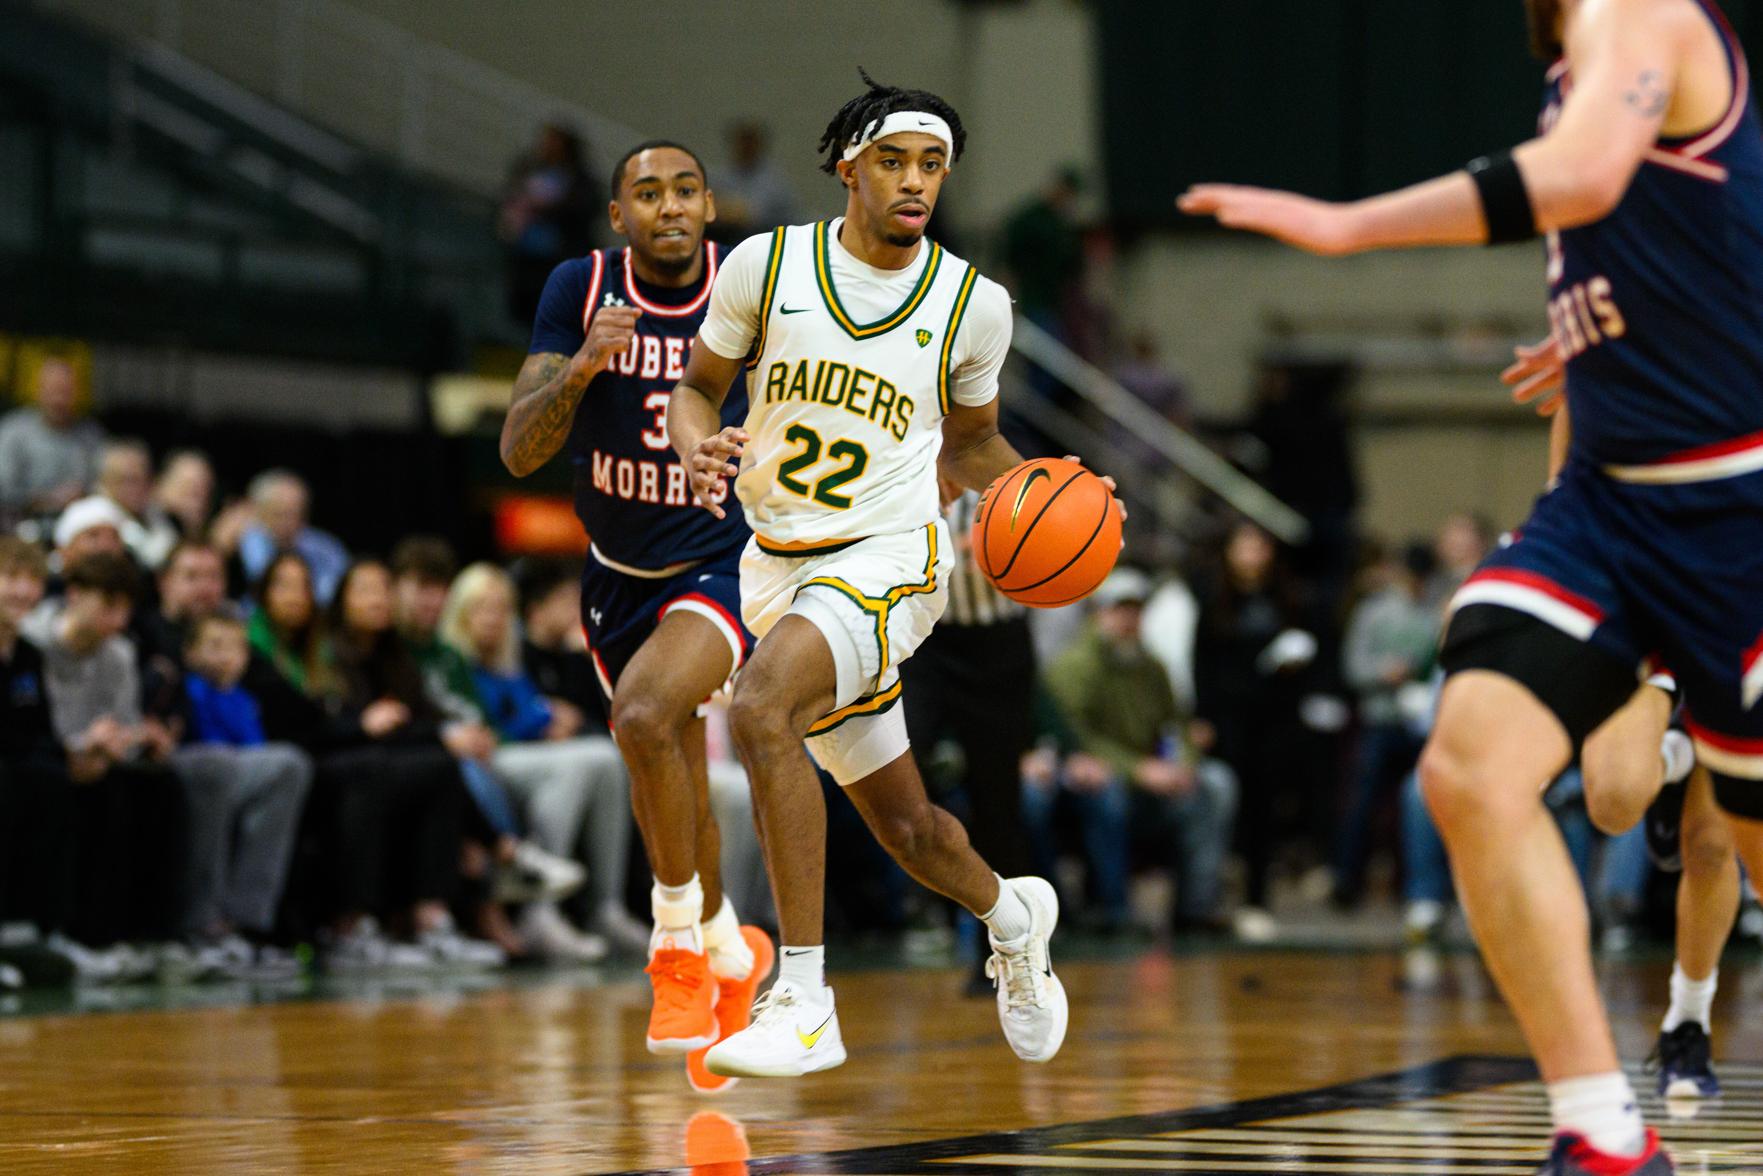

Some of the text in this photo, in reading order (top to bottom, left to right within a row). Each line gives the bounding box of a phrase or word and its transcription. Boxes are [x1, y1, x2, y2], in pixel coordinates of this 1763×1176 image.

[641, 391, 675, 450] 3
[765, 358, 916, 444] RAIDERS
[592, 449, 729, 507] MORRS
[776, 420, 871, 510] 22
